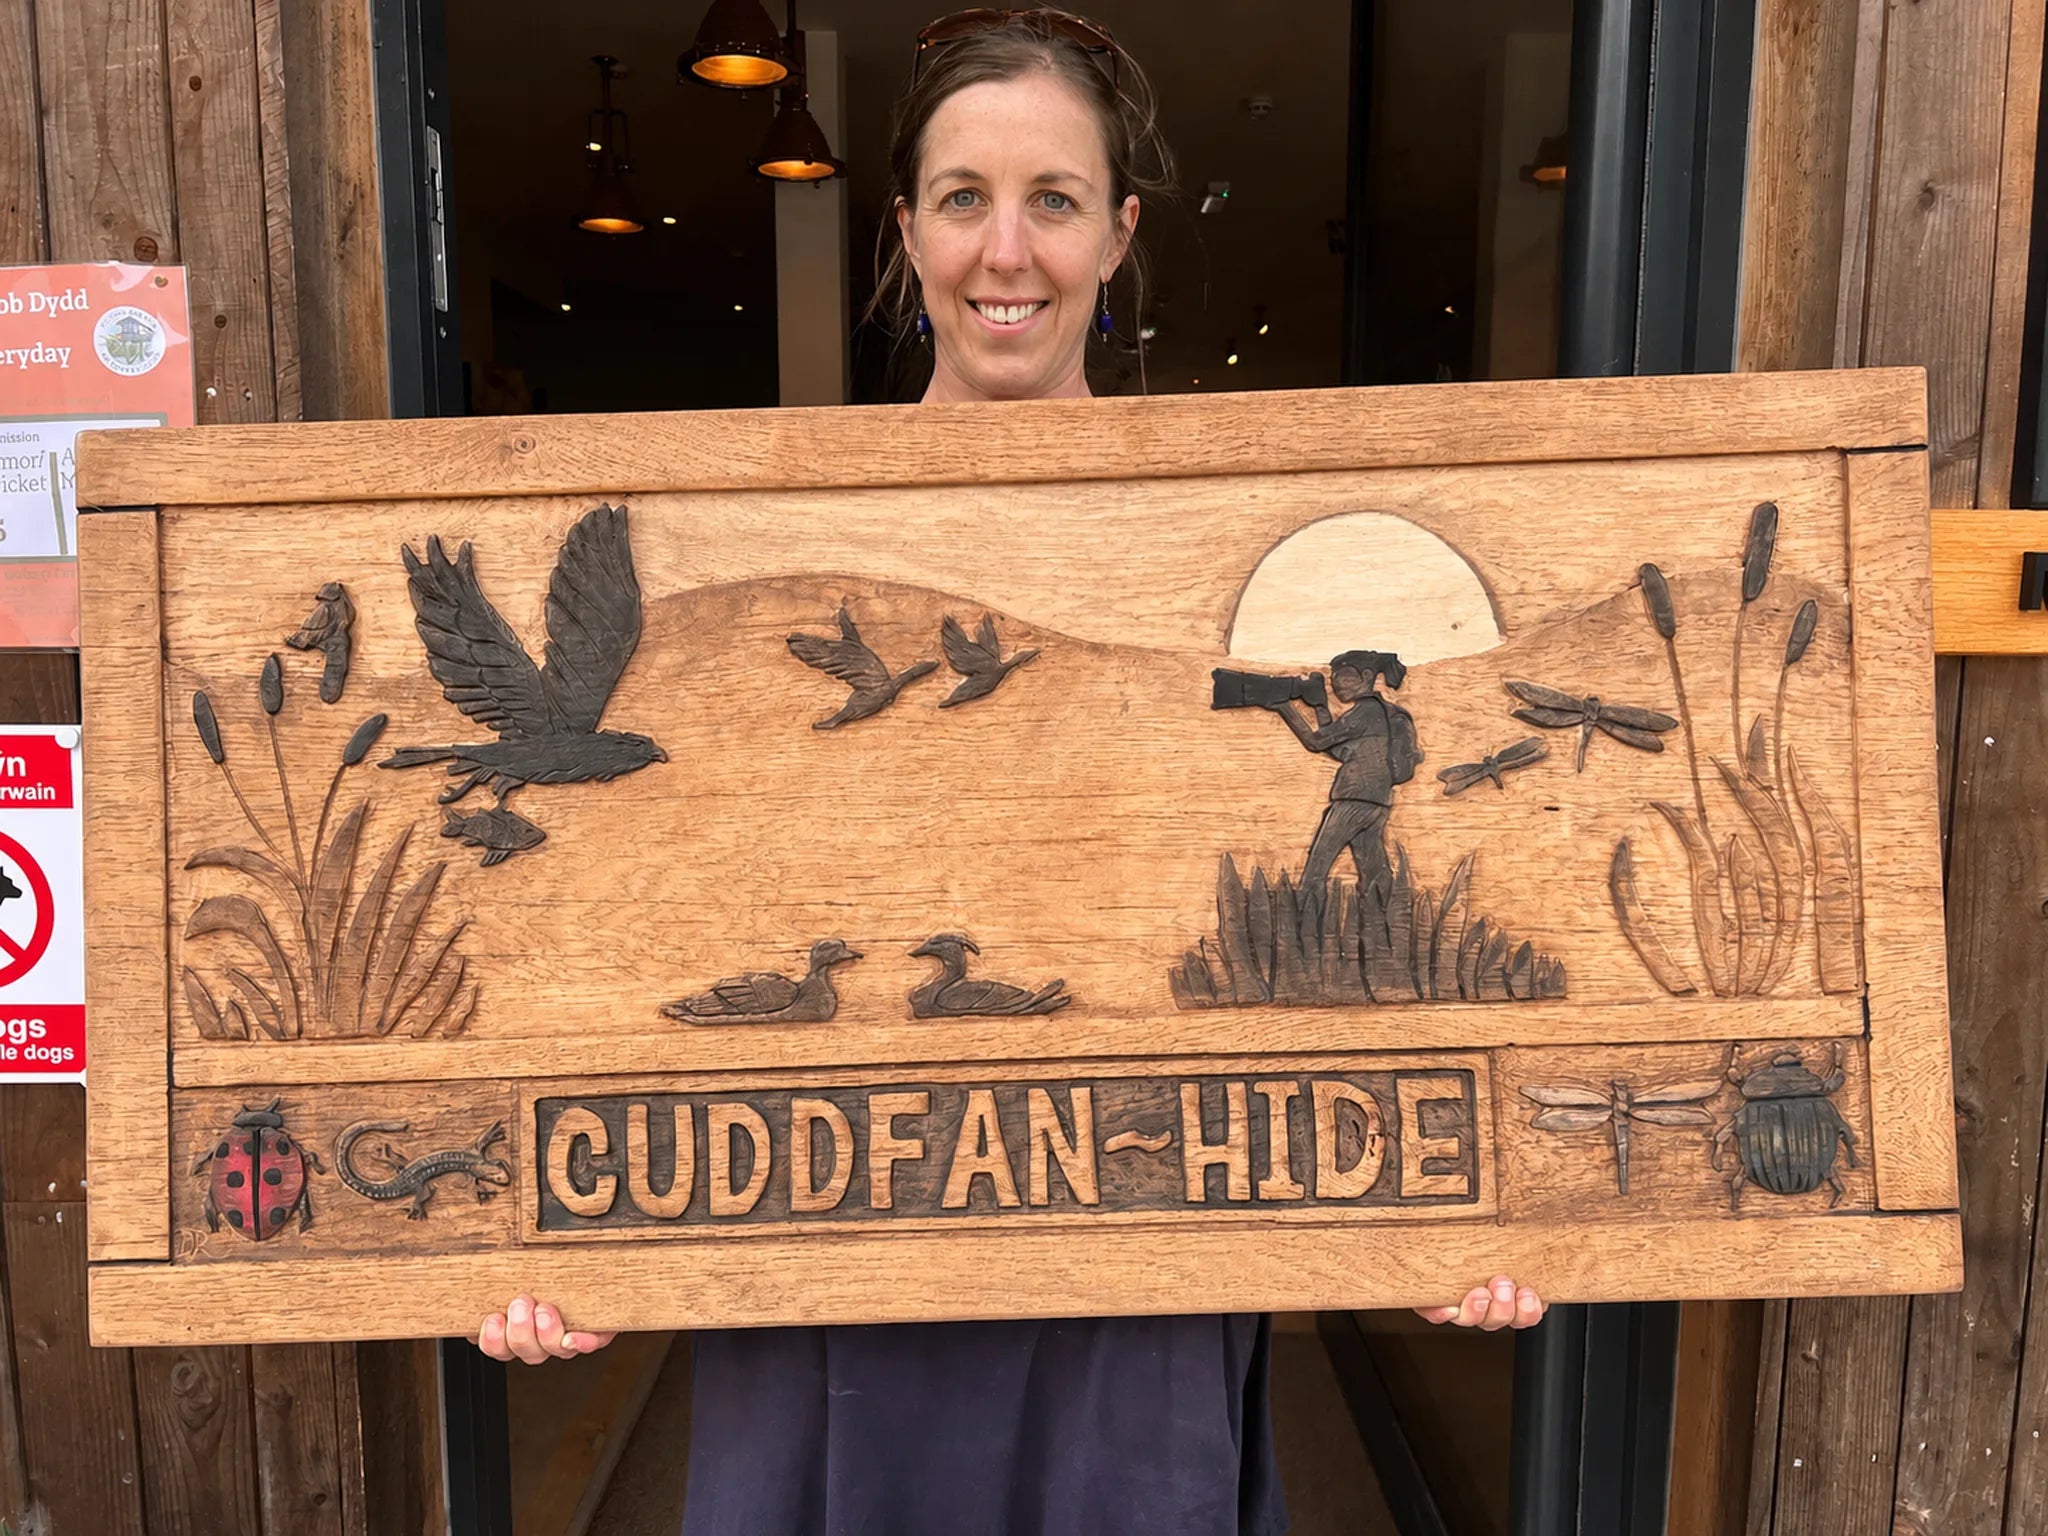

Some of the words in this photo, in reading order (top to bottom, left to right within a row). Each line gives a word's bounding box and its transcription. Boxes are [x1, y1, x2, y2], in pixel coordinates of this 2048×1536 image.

[28, 288, 89, 318] Dydd
[2, 473, 47, 493] icket
[0, 750, 26, 777] n
[0, 782, 56, 800] rwain
[24, 1044, 74, 1065] dogs
[1179, 1076, 1470, 1203] HIDE
